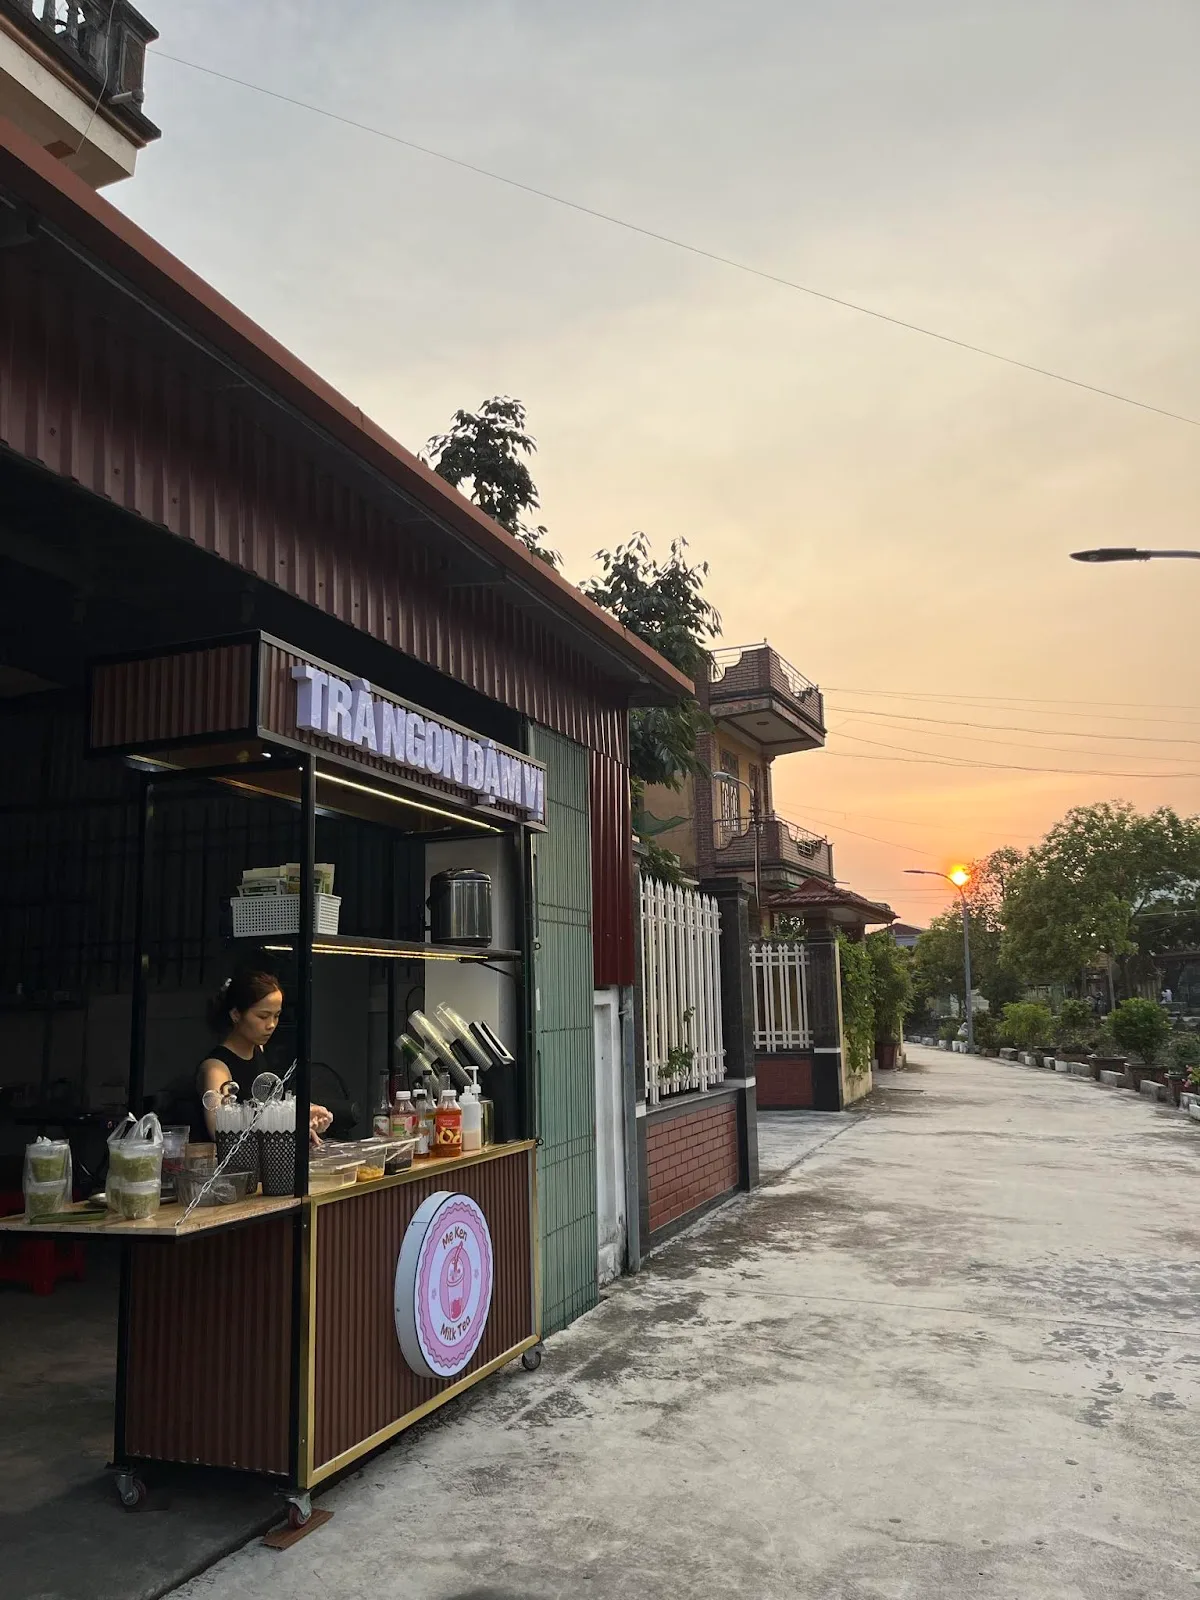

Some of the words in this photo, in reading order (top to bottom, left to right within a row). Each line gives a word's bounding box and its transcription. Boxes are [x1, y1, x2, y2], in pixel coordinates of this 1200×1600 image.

[292, 664, 378, 752] TRÀ
[377, 700, 463, 785] NGON
[454, 1226, 467, 1241] Ken
[440, 1323, 456, 1341] Milk
[457, 1316, 470, 1336] Tea
